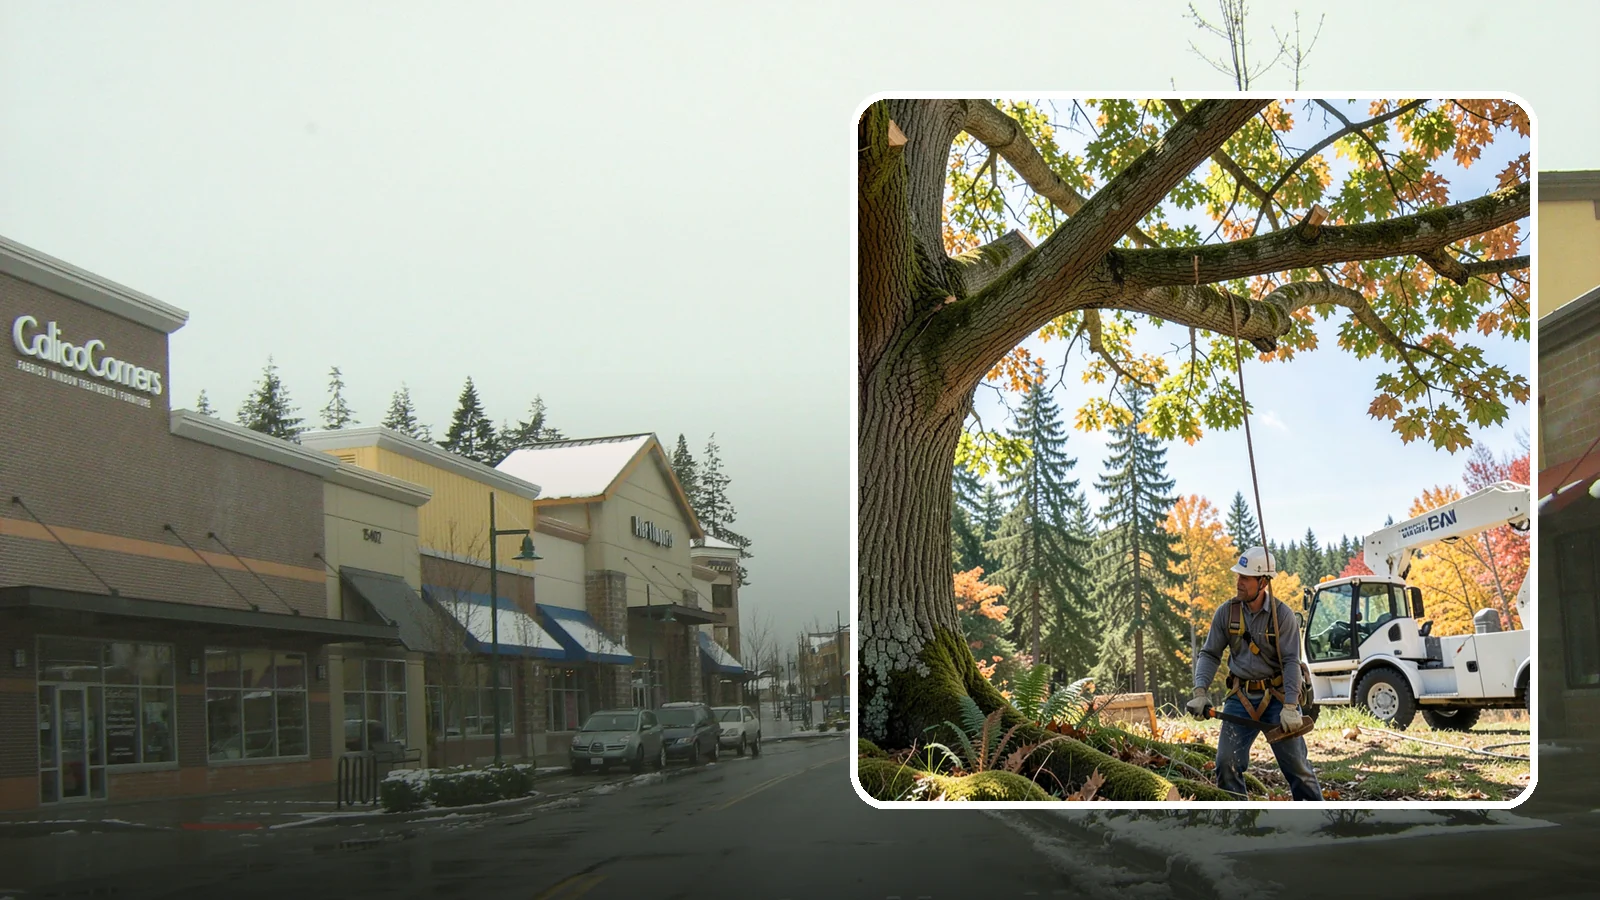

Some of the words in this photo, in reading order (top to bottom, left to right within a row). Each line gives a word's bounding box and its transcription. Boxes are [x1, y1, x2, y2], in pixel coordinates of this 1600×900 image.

[17, 360, 47, 378] FABRICS
[51, 370, 78, 387] WINDOW
[78, 378, 117, 398] TREATMENTS
[120, 390, 152, 409] FURNITURE
